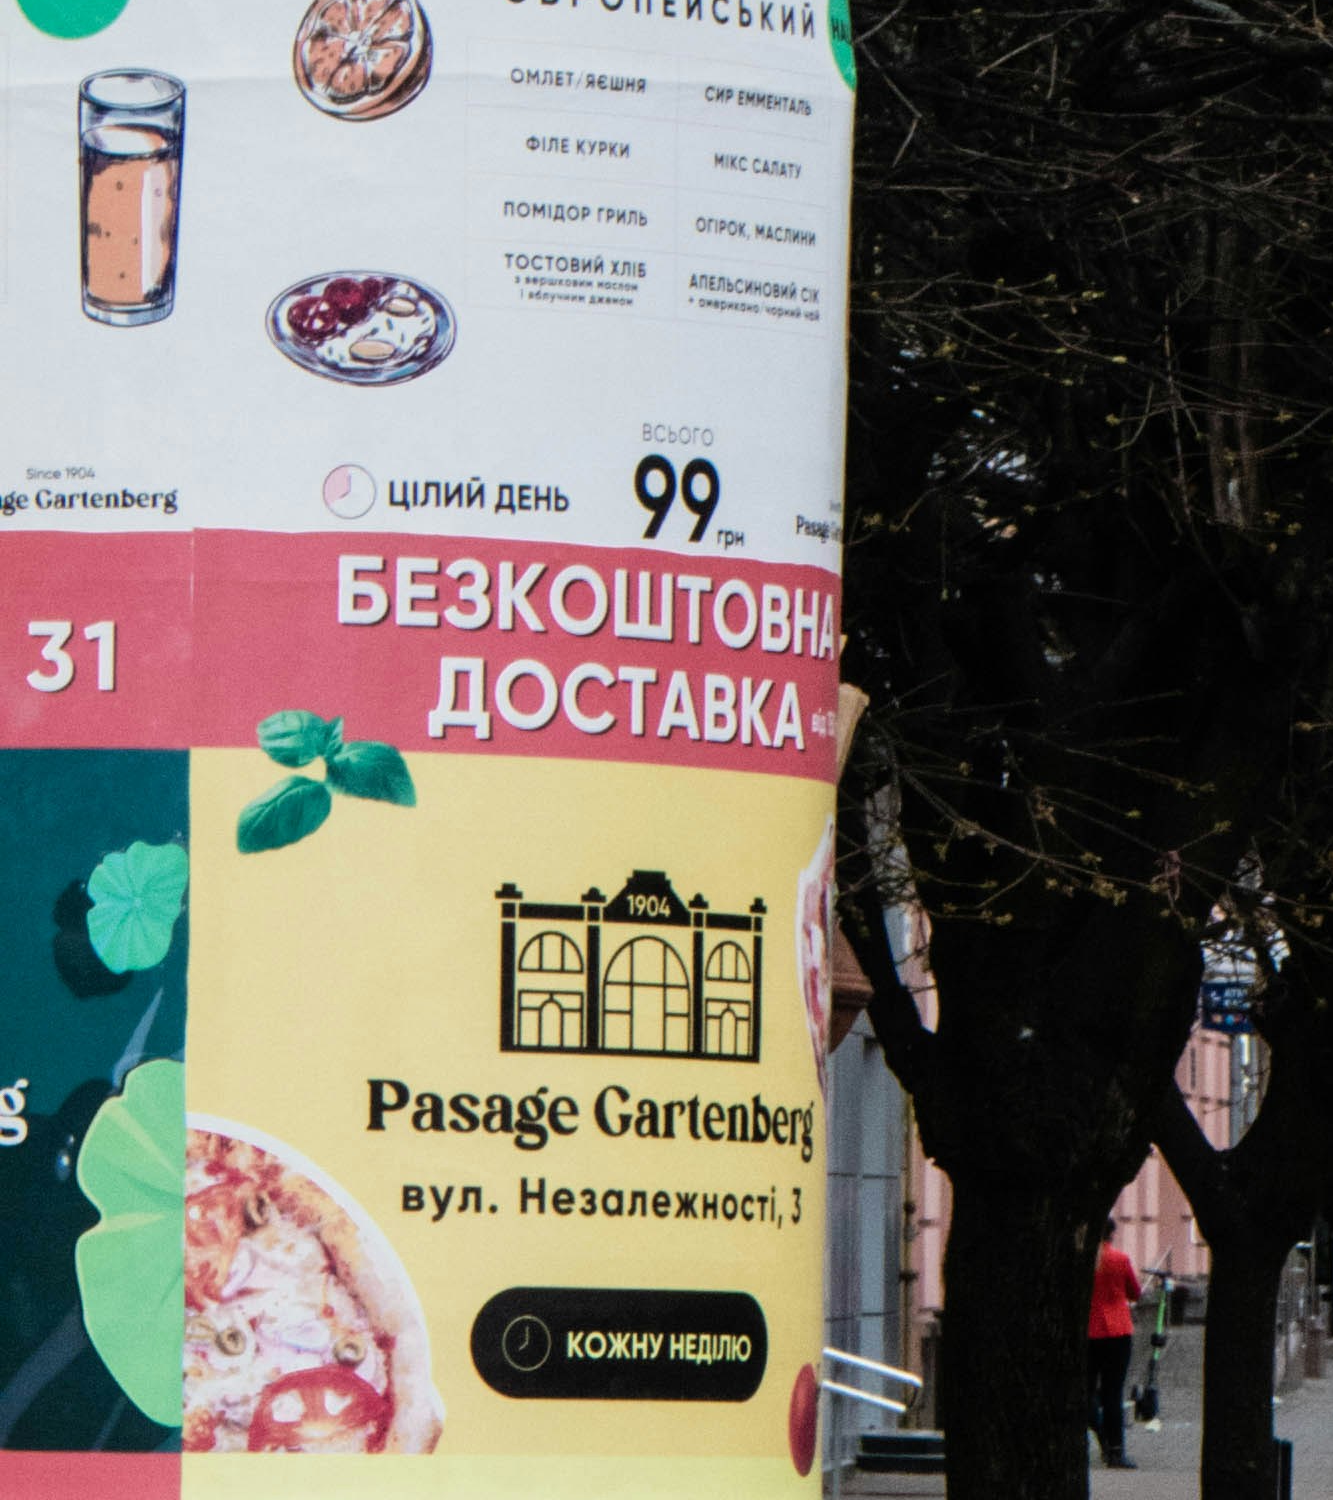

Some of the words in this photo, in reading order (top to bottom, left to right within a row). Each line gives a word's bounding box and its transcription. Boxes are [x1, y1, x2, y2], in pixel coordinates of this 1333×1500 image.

[510, 67, 648, 94] ОМЛЕТ/ЯЄШНЯ
[704, 85, 734, 105] СИР
[737, 90, 812, 117] ЕММЕНТАЛЬ
[526, 135, 570, 155] ФІЛЕ
[576, 138, 631, 159] КУРКИ
[714, 152, 748, 172] МІКС
[752, 158, 802, 180] САЛАТУ
[503, 200, 591, 223] ПОМІДОР
[754, 223, 817, 247] МАСЛИНИ
[504, 252, 605, 275] ТОСТОВИЙ
[610, 260, 647, 279] ХЛІБ
[688, 273, 798, 301] АПЕЛЬСИНОВИЙ
[800, 286, 821, 304] СІК
[641, 422, 715, 448] ВСЬОГО
[26, 467, 61, 480] Since
[65, 466, 96, 480] 1904
[0, 490, 29, 516] ge
[35, 488, 179, 515] Gartenberg
[388, 476, 485, 512] ЦІЛИЙ
[494, 483, 570, 516] ДЕНЬ
[634, 453, 721, 543] 99
[716, 526, 745, 550] грн
[337, 554, 836, 661] БЕЗКОШТОВНА
[26, 620, 116, 693] 31
[427, 655, 806, 752] ДОСТАВКА
[626, 894, 672, 918] 1904
[366, 1078, 579, 1151] Pasage
[594, 1084, 815, 1164] Gartenberg
[401, 1182, 499, 1223] вул.
[518, 1176, 783, 1230] Незалежності,
[791, 1186, 802, 1225] 3
[566, 1330, 664, 1361] КОЖНУ
[668, 1333, 752, 1367] НЕДІЛЮ
